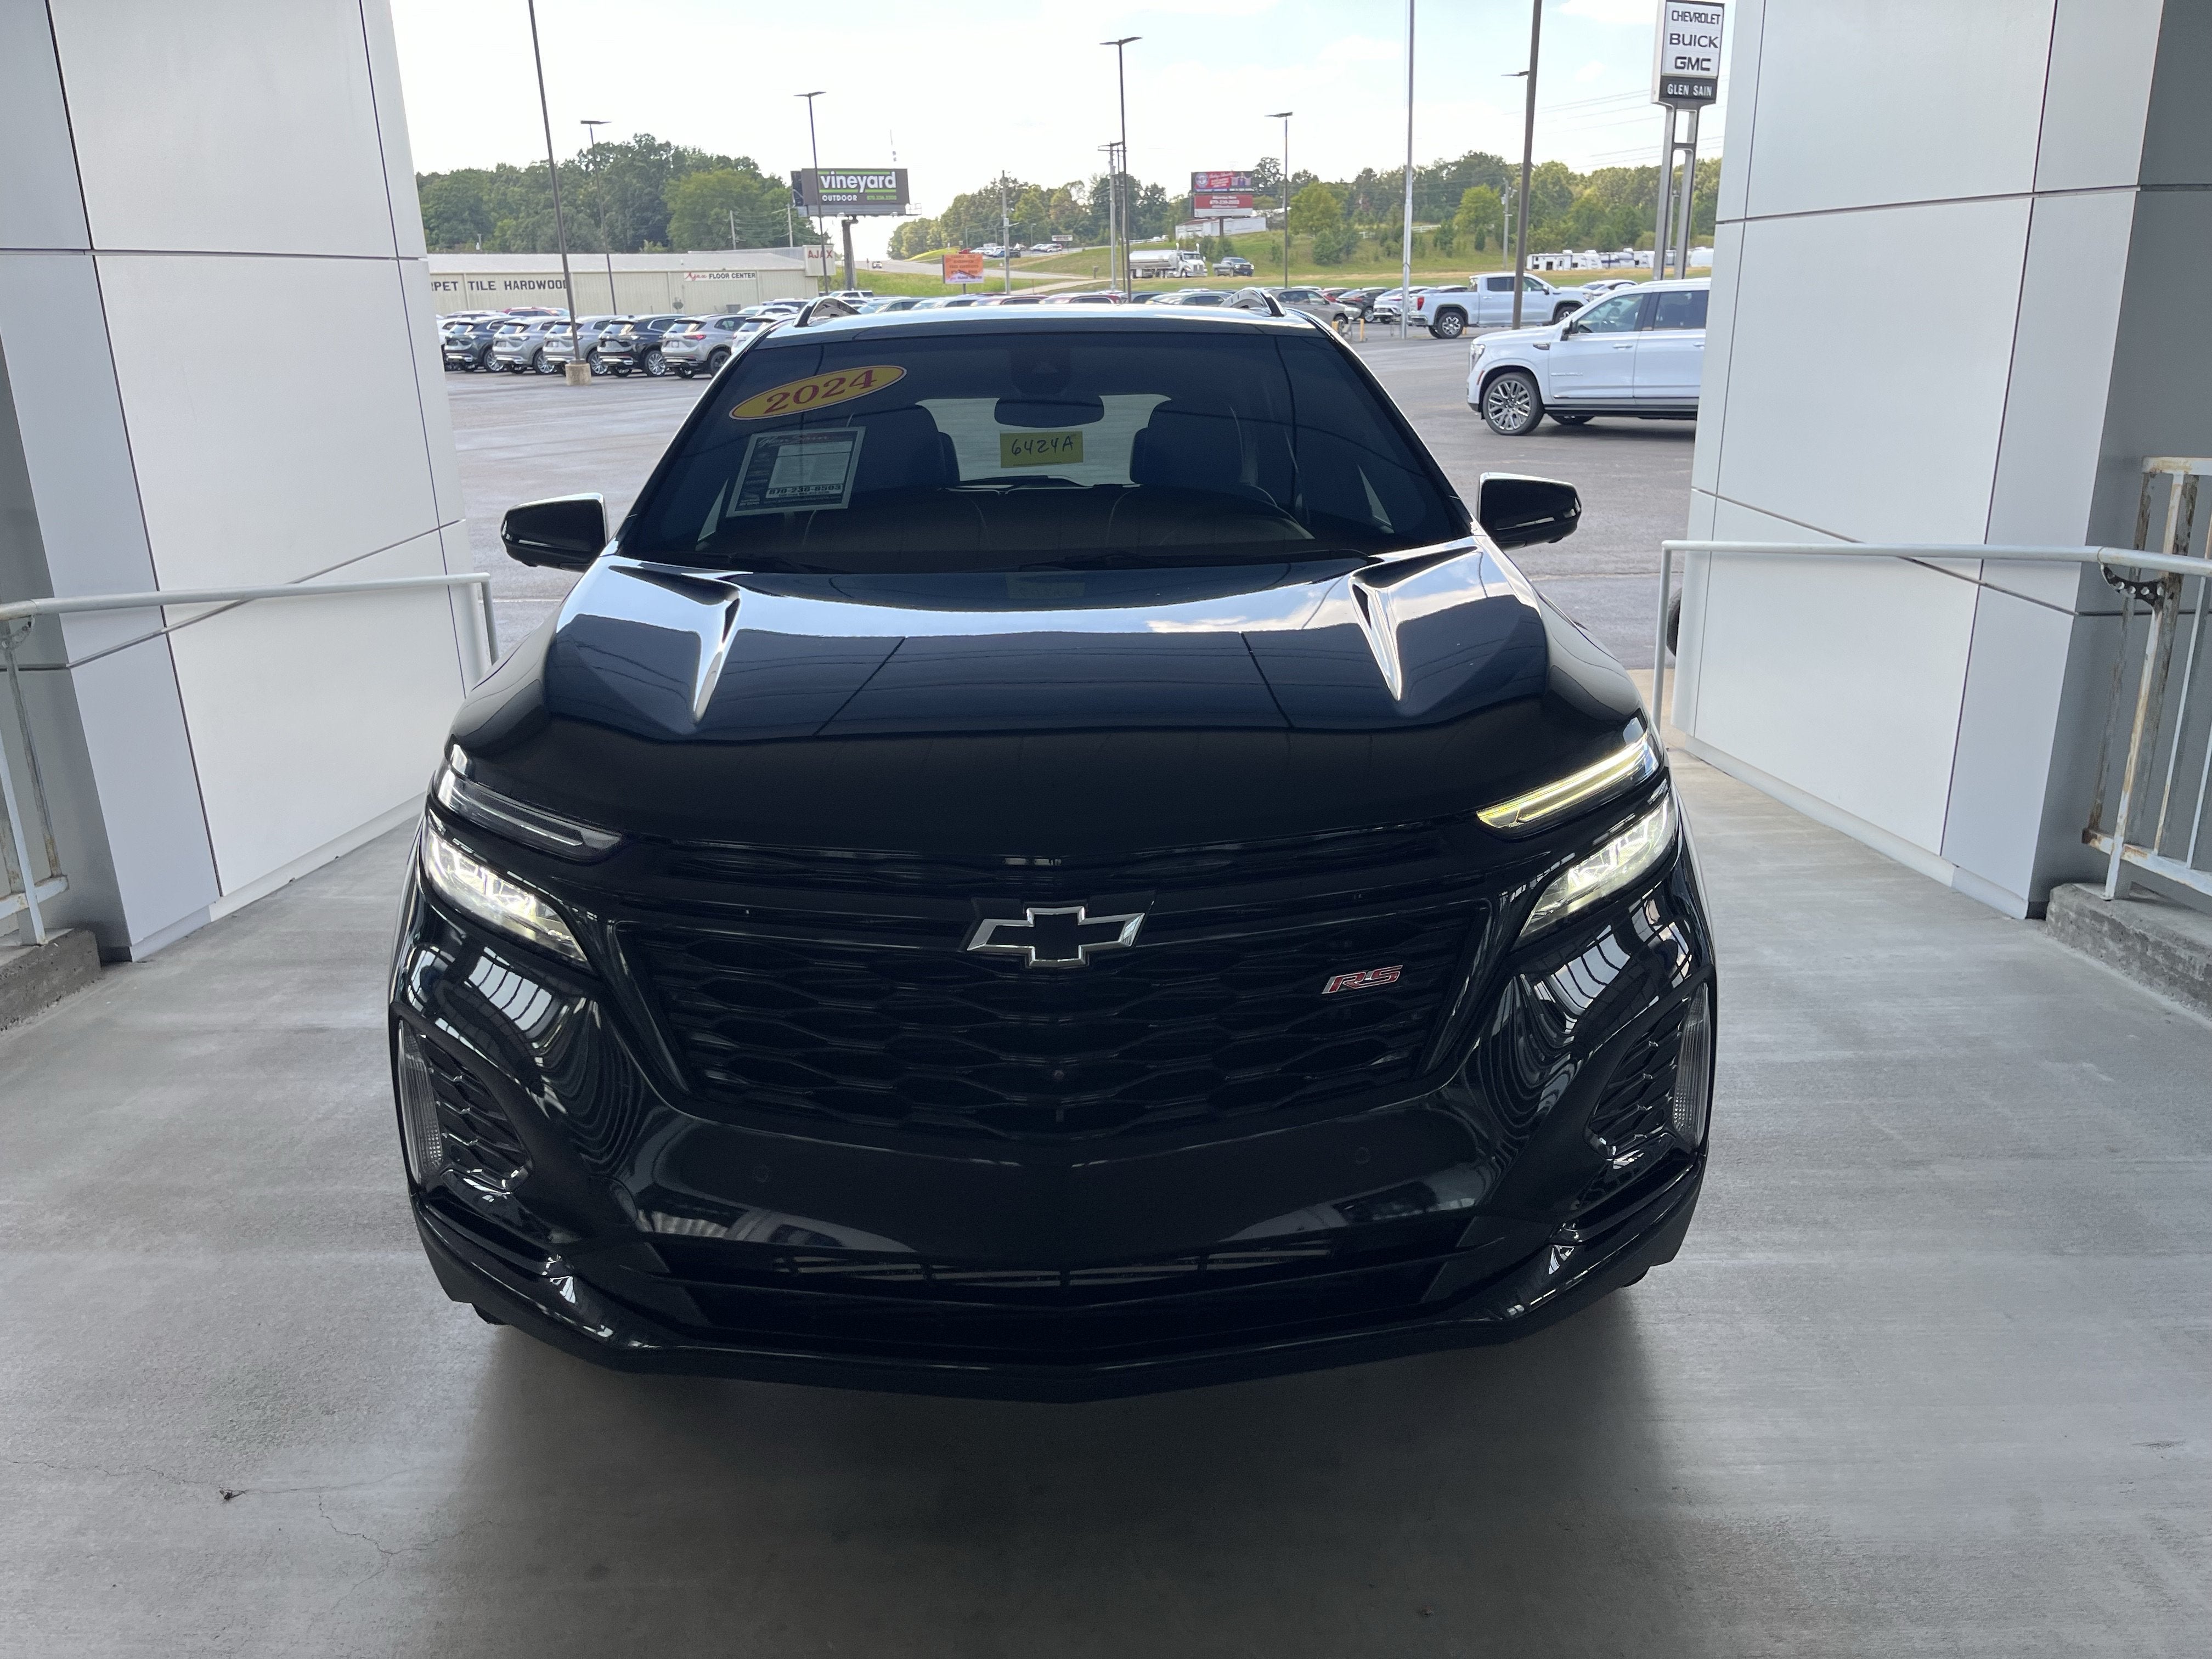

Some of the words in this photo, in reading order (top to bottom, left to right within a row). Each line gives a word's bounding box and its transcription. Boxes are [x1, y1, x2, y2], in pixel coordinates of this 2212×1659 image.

[1671, 10, 1721, 25] CHEVROLET
[1669, 32, 1719, 48] BUICK
[1674, 56, 1711, 71] GMC
[1667, 83, 1690, 96] GLEN
[1692, 84, 1712, 97] SAIN
[820, 171, 896, 193] vineyard
[467, 280, 496, 291] TILE
[763, 369, 878, 414] 2024
[1011, 435, 1074, 456] 6424A
[1321, 964, 1403, 995] RS
